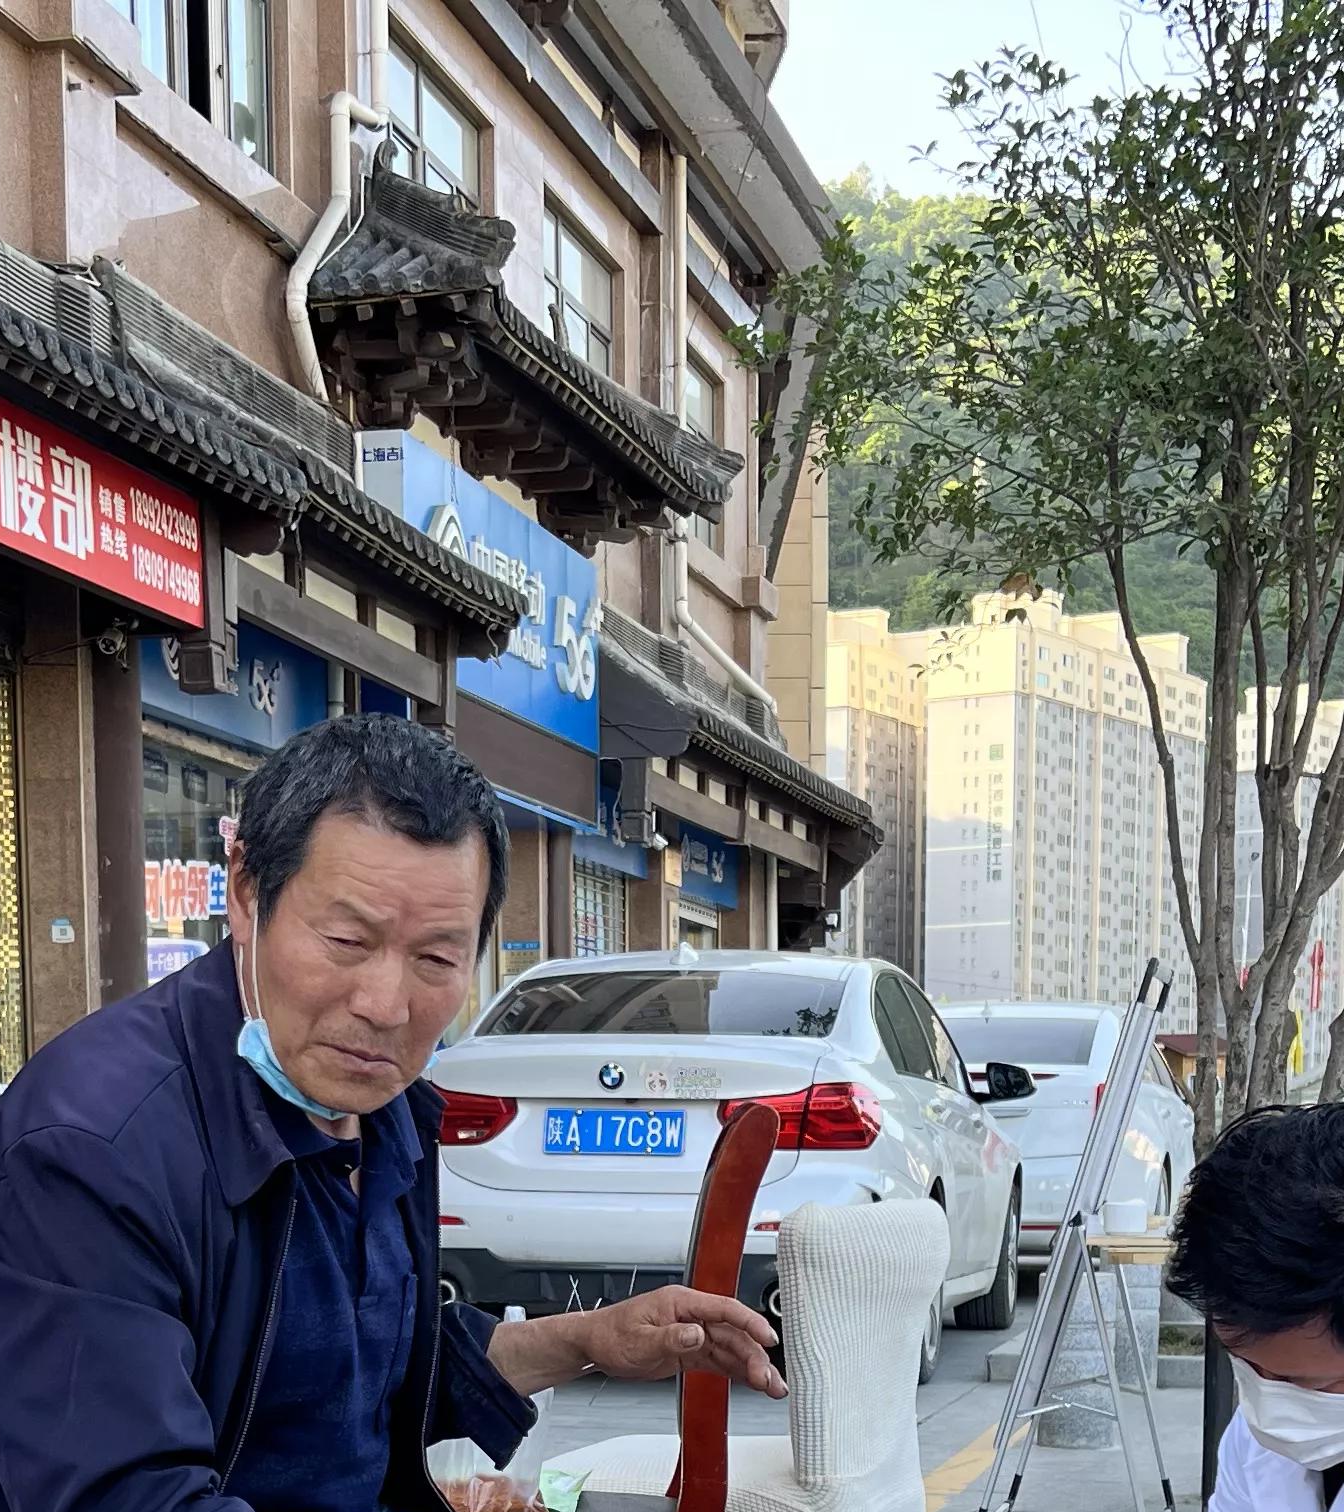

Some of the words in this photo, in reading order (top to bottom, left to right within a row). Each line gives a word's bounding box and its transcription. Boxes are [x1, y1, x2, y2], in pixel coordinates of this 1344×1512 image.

[99, 484, 126, 525] 销售
[129, 486, 198, 552] 18992423999
[100, 521, 128, 561] 热线
[131, 543, 200, 607] 18909149968
